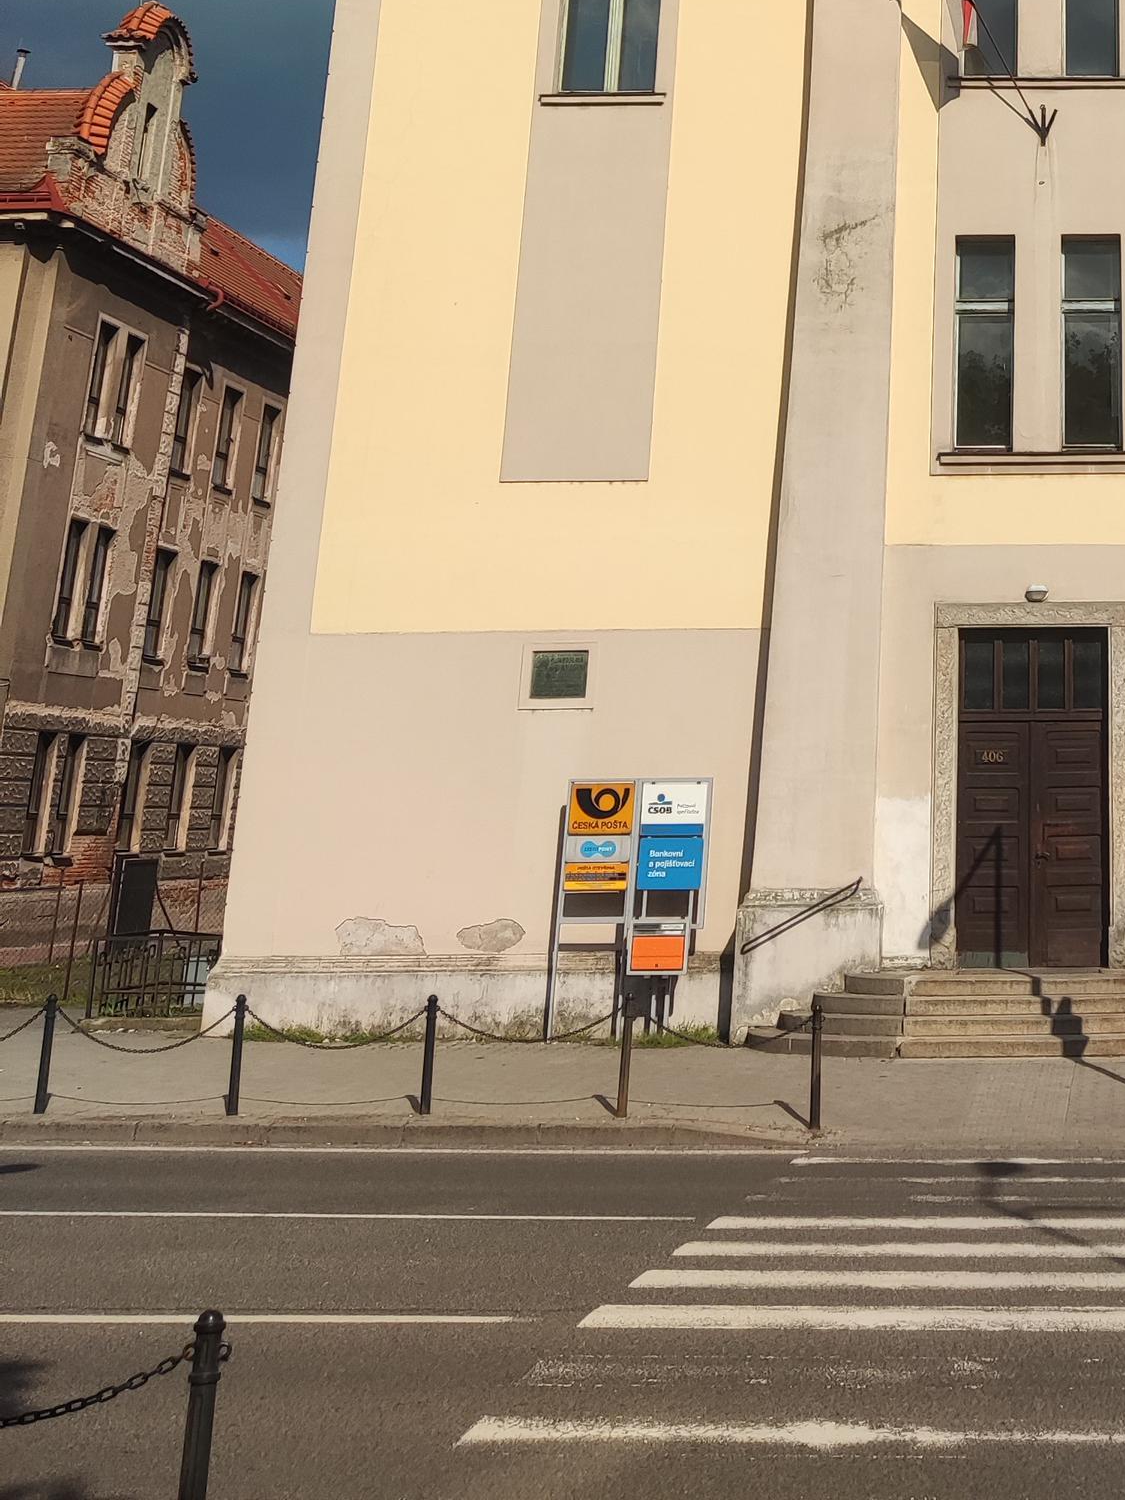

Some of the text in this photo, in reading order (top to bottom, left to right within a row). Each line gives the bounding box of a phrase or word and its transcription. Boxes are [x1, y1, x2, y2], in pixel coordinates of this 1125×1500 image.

[982, 749, 1004, 762] 406
[647, 805, 673, 815] ČSOB
[572, 819, 628, 830] ČESKÁ POŠTA
[649, 849, 684, 858] Bankovní
[655, 859, 695, 869] pojišťovací
[647, 870, 666, 878] zóna
